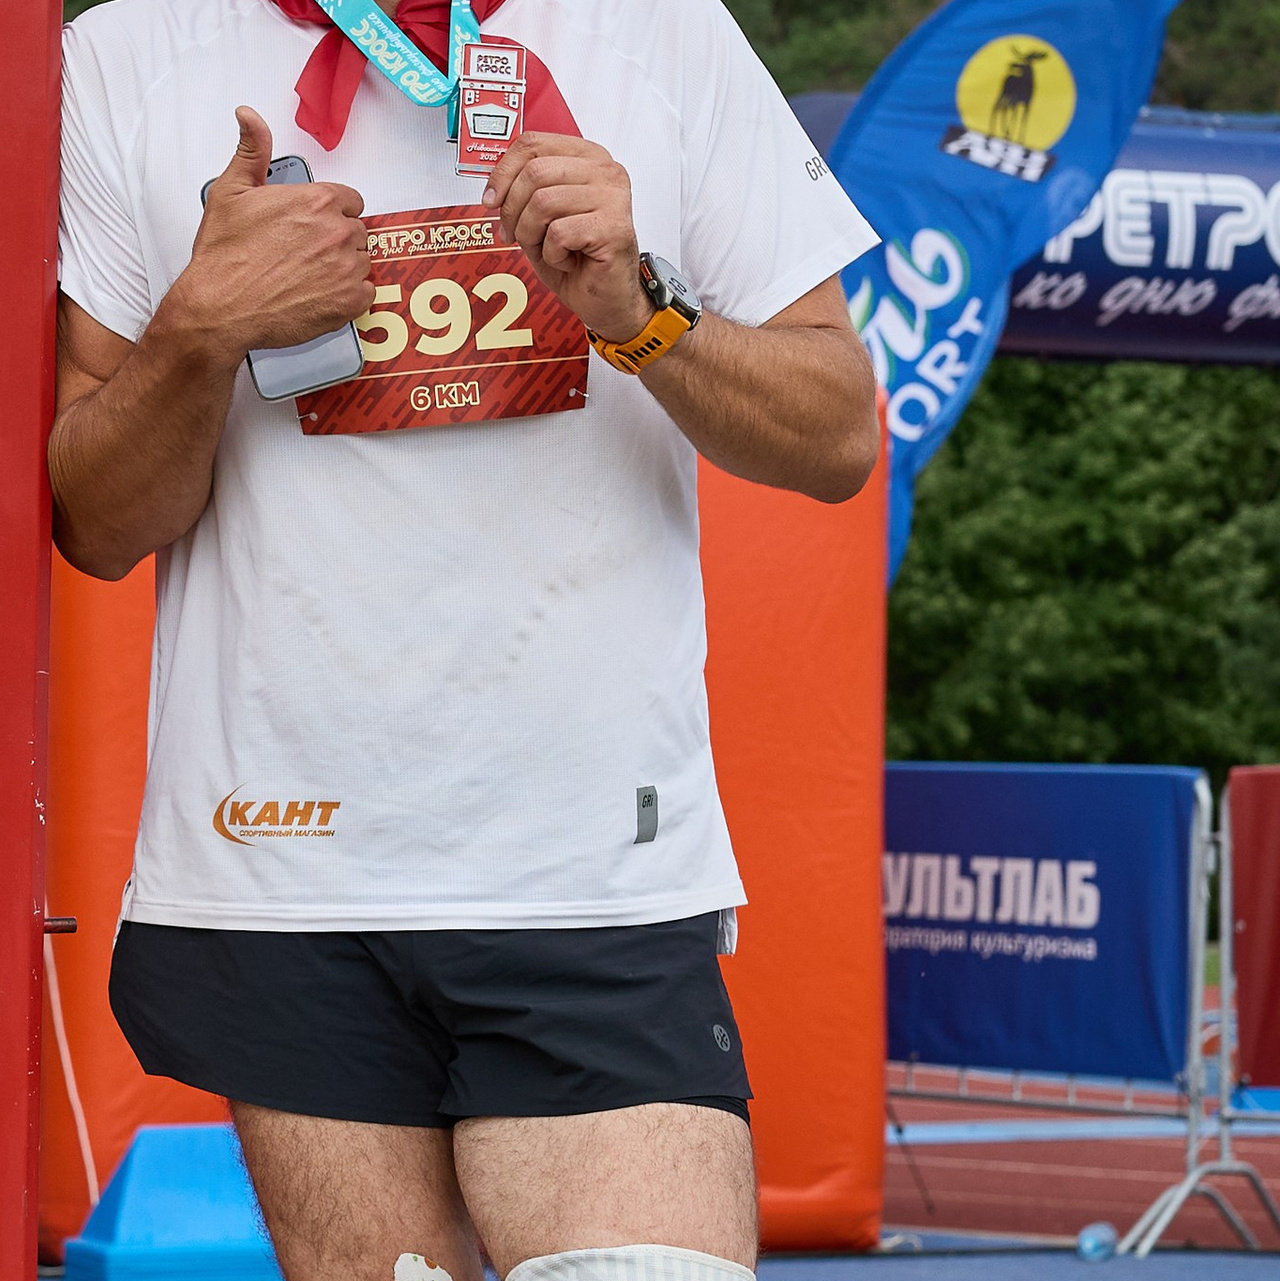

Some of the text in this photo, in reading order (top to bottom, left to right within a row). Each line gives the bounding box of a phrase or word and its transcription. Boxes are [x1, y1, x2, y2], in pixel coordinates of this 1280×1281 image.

[349, 18, 408, 76] КРОСС
[477, 54, 509, 66] РЕТРО
[476, 64, 511, 75] КРОСС
[805, 156, 828, 181] GR
[1043, 168, 1280, 271] РЕТР
[367, 223, 494, 251] РЕТРО КРОСС
[408, 238, 494, 255] физкультурника
[355, 273, 534, 362] 592
[886, 296, 985, 443] ORT
[411, 381, 480, 411] 6 КМ
[228, 801, 341, 826] КАНТ
[239, 828, 336, 838] СПОРТИВНЫЙ МАГАЗИН
[884, 852, 1101, 930] УЛЬТЛАБ
[886, 926, 968, 957] ратория
